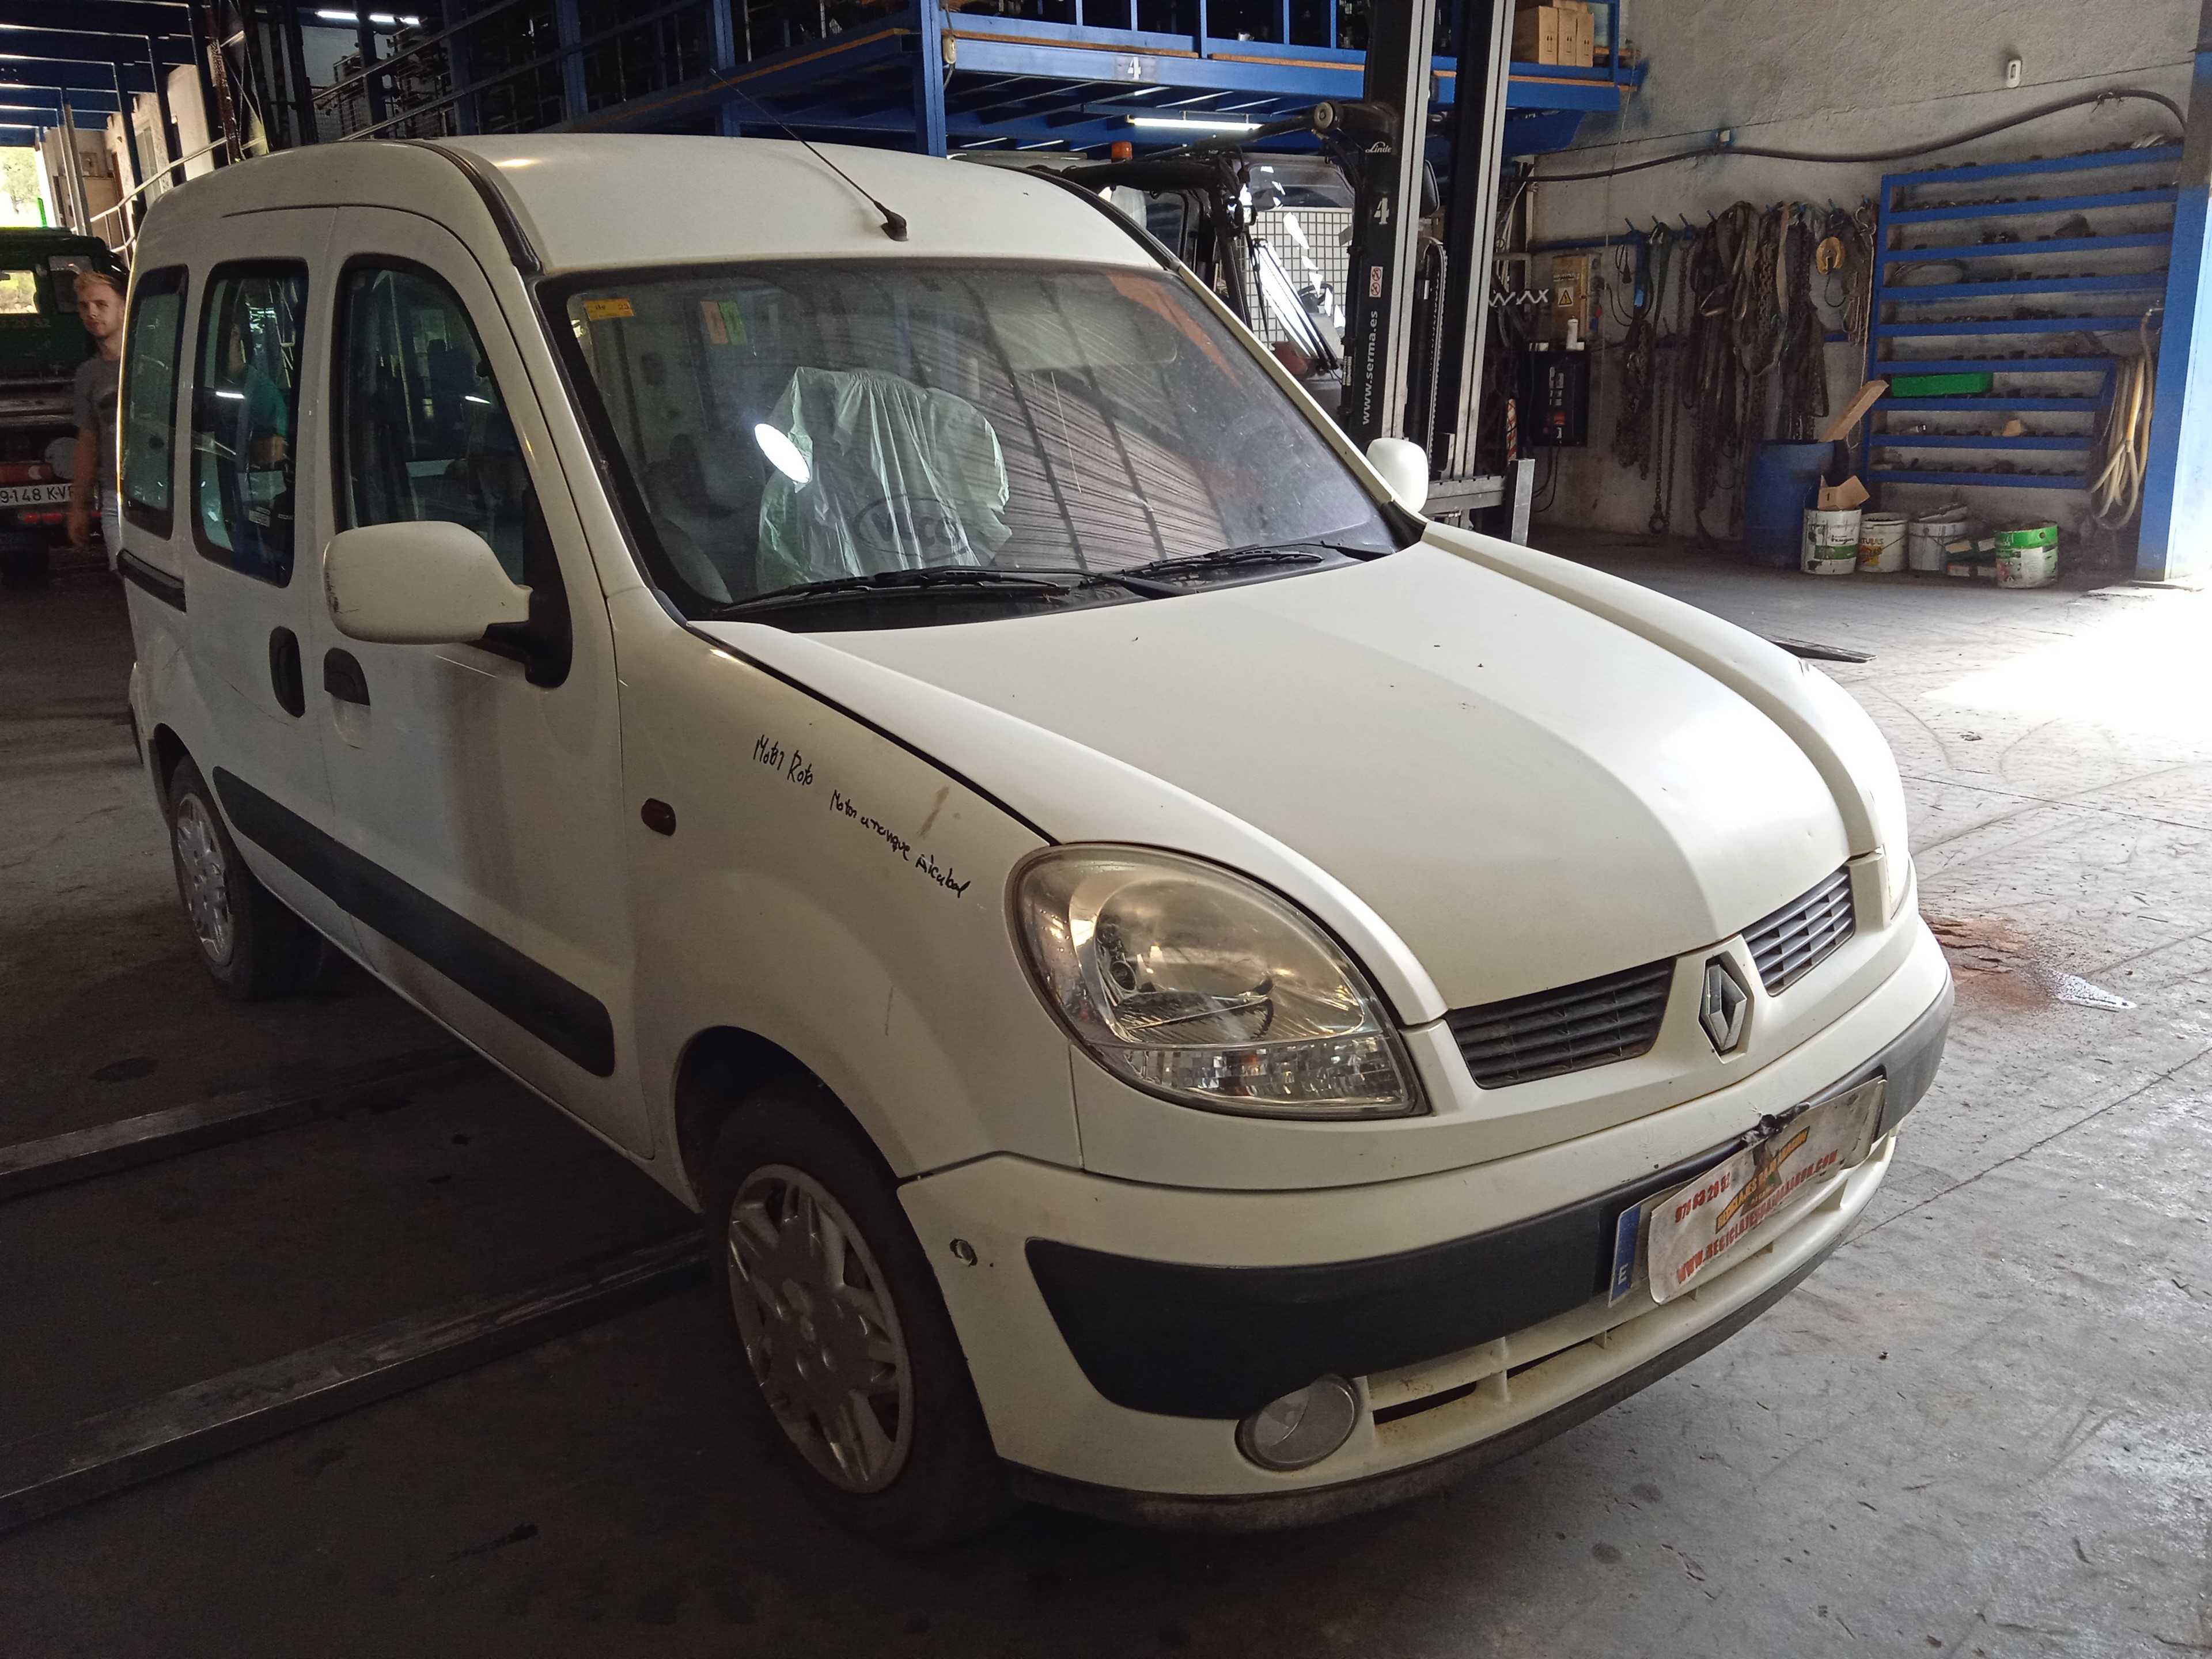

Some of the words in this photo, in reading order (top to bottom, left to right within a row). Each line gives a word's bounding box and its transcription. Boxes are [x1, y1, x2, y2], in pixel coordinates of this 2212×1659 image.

[1127, 56, 1141, 79] 4
[1365, 142, 1392, 153] Linde
[1374, 198, 1389, 225] 4
[1363, 310, 1378, 425] www.serma.es
[1618, 1263, 1628, 1285] E
